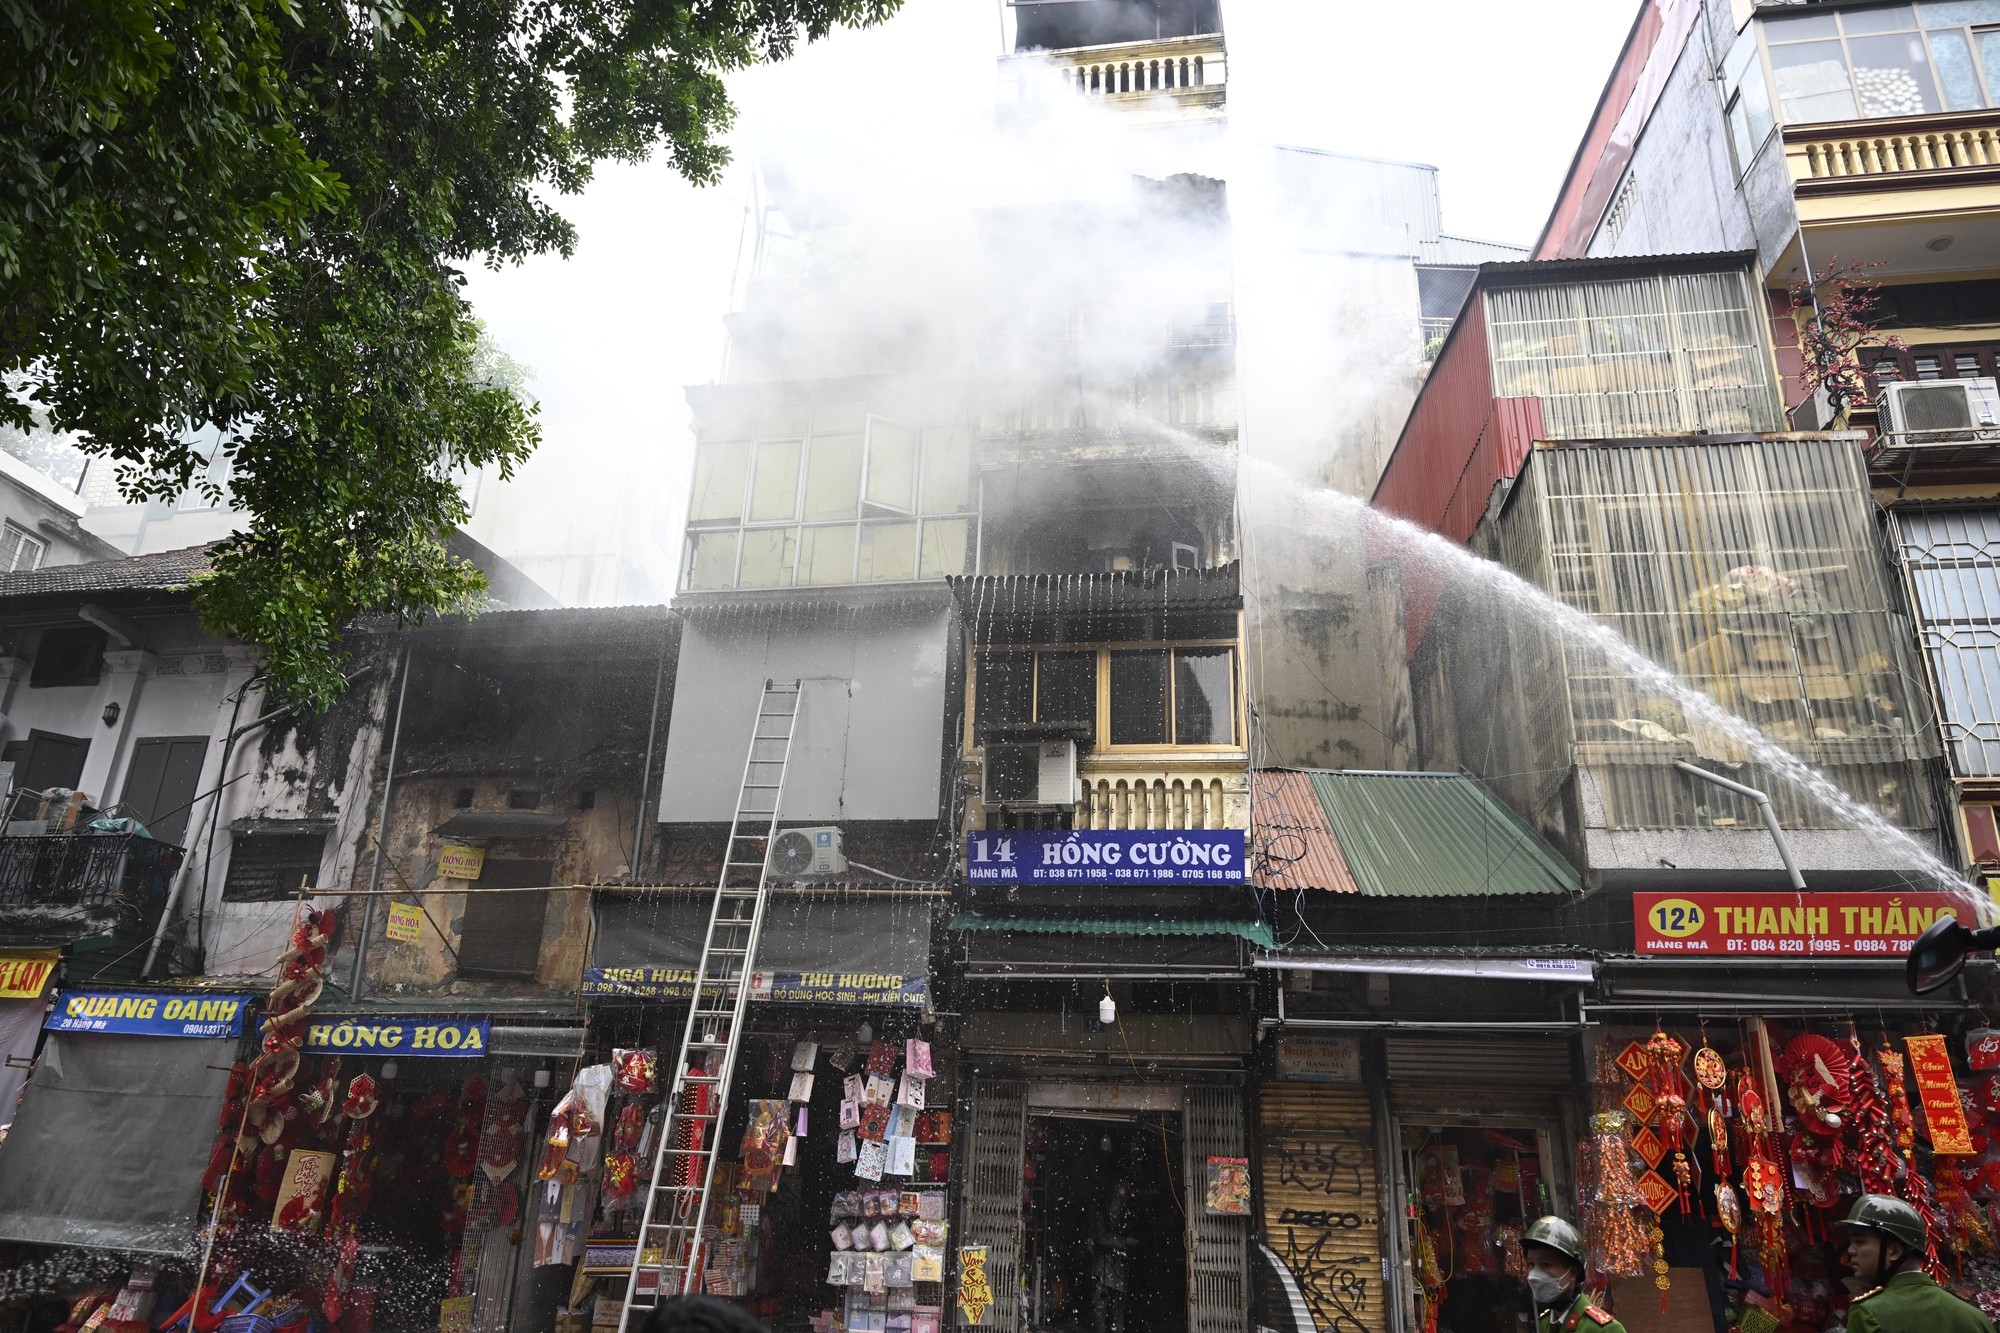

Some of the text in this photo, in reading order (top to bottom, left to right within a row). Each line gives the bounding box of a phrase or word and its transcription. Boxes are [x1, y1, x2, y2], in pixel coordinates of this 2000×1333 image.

[972, 831, 1232, 866] 14 HỒNG CƯỜNG
[465, 857, 480, 867] HOA
[970, 866, 1018, 878] HÀNG MÃ
[1033, 868, 1047, 878] ĐT:
[1049, 868, 1065, 878] 038
[1067, 868, 1082, 878] 671
[1086, 868, 1107, 878] 1958
[1115, 868, 1131, 878] 038
[1133, 868, 1149, 878] 671
[1152, 869, 1174, 879] 1986
[1182, 870, 1204, 879] 0705
[1207, 870, 1223, 879] 168
[1225, 870, 1242, 879] 980
[405, 917, 419, 929] HOA
[1713, 906, 1829, 935] THANH
[1646, 939, 1709, 949] HÀNG MÃ
[1726, 939, 1748, 951] ĐT:
[1751, 939, 1776, 951] 084
[1779, 939, 1804, 951] 820
[1808, 939, 1841, 952] 1995
[1853, 940, 1887, 952] 0984
[603, 968, 644, 982] NGA
[839, 973, 903, 989] HƯƠNG
[597, 982, 613, 993] 098
[616, 984, 632, 993] 721
[635, 986, 657, 996] 8268
[664, 986, 680, 996] 098
[788, 987, 813, 1000] DÙNG
[836, 991, 856, 1002] SINH
[902, 992, 925, 1003] CUTE
[66, 997, 239, 1022] QUANG OANH
[60, 1018, 72, 1028] 20
[72, 1018, 92, 1030] Hàng
[306, 1017, 484, 1050] HỒNG HOA
[1625, 1051, 1648, 1071] AN
